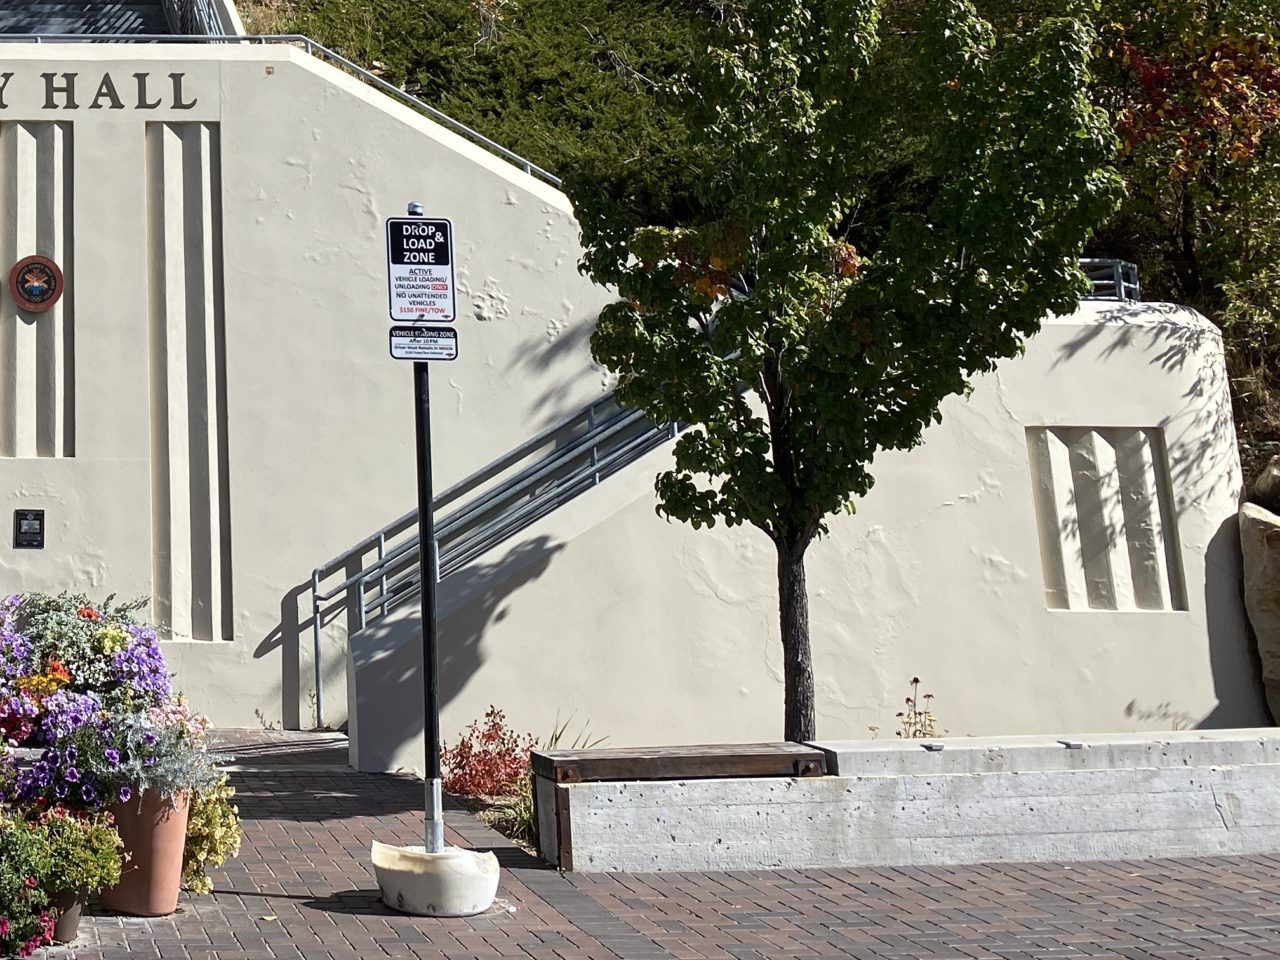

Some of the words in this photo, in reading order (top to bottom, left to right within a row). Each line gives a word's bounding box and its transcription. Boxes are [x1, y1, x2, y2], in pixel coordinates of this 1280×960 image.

[39, 71, 198, 110] HALL
[402, 225, 436, 236] DROP
[434, 231, 445, 243] &
[403, 238, 435, 249] LOAD
[403, 251, 436, 263] ZONE
[409, 268, 433, 276] ACTIVE
